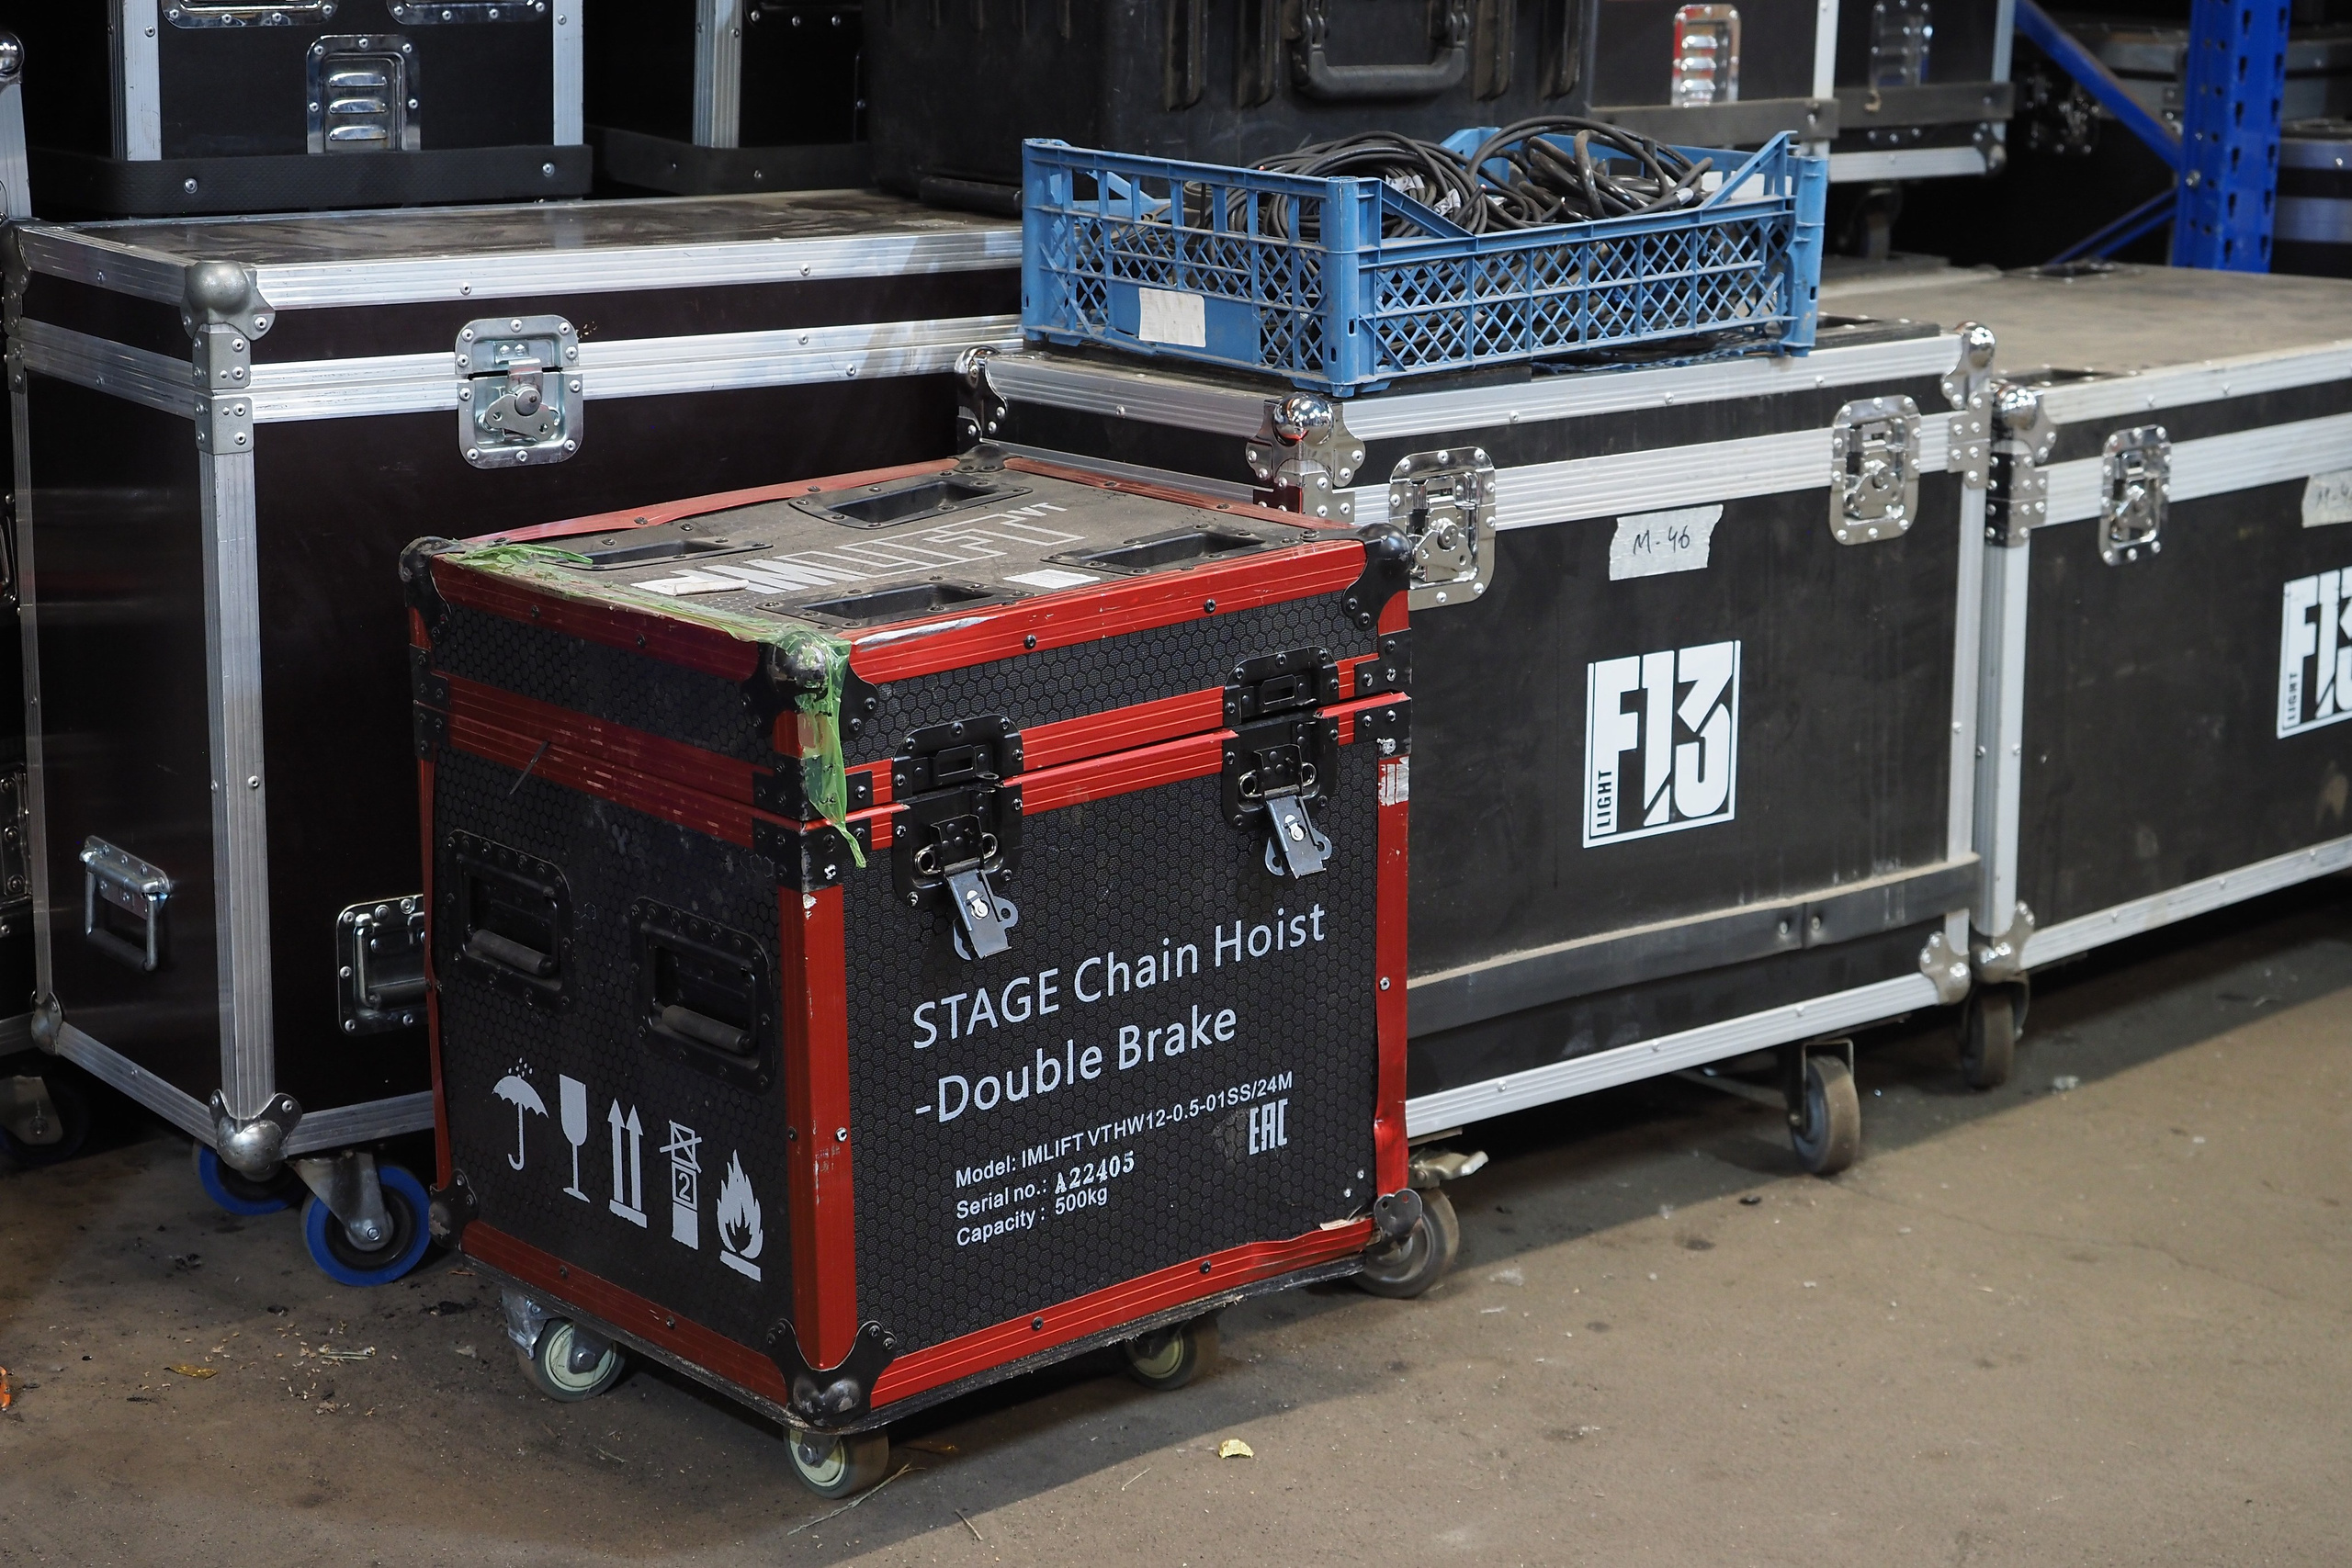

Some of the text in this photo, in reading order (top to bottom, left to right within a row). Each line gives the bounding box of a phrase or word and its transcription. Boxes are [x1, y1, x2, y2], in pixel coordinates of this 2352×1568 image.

[1590, 640, 1735, 838] F13
[1596, 769, 1612, 829] LIGHT
[912, 903, 1325, 1049] STAGE Chain Hoist
[914, 1004, 1237, 1122] -Double Brake
[1249, 1098, 1289, 1156] EAC
[678, 1172, 691, 1201] 2
[956, 1155, 1016, 1189] Model:
[1022, 1132, 1084, 1168] IMLIFT
[956, 1186, 1009, 1220] Serial
[1054, 1149, 1135, 1195] A22405
[956, 1209, 1036, 1247] Capacity
[1055, 1187, 1108, 1215] 500kg
